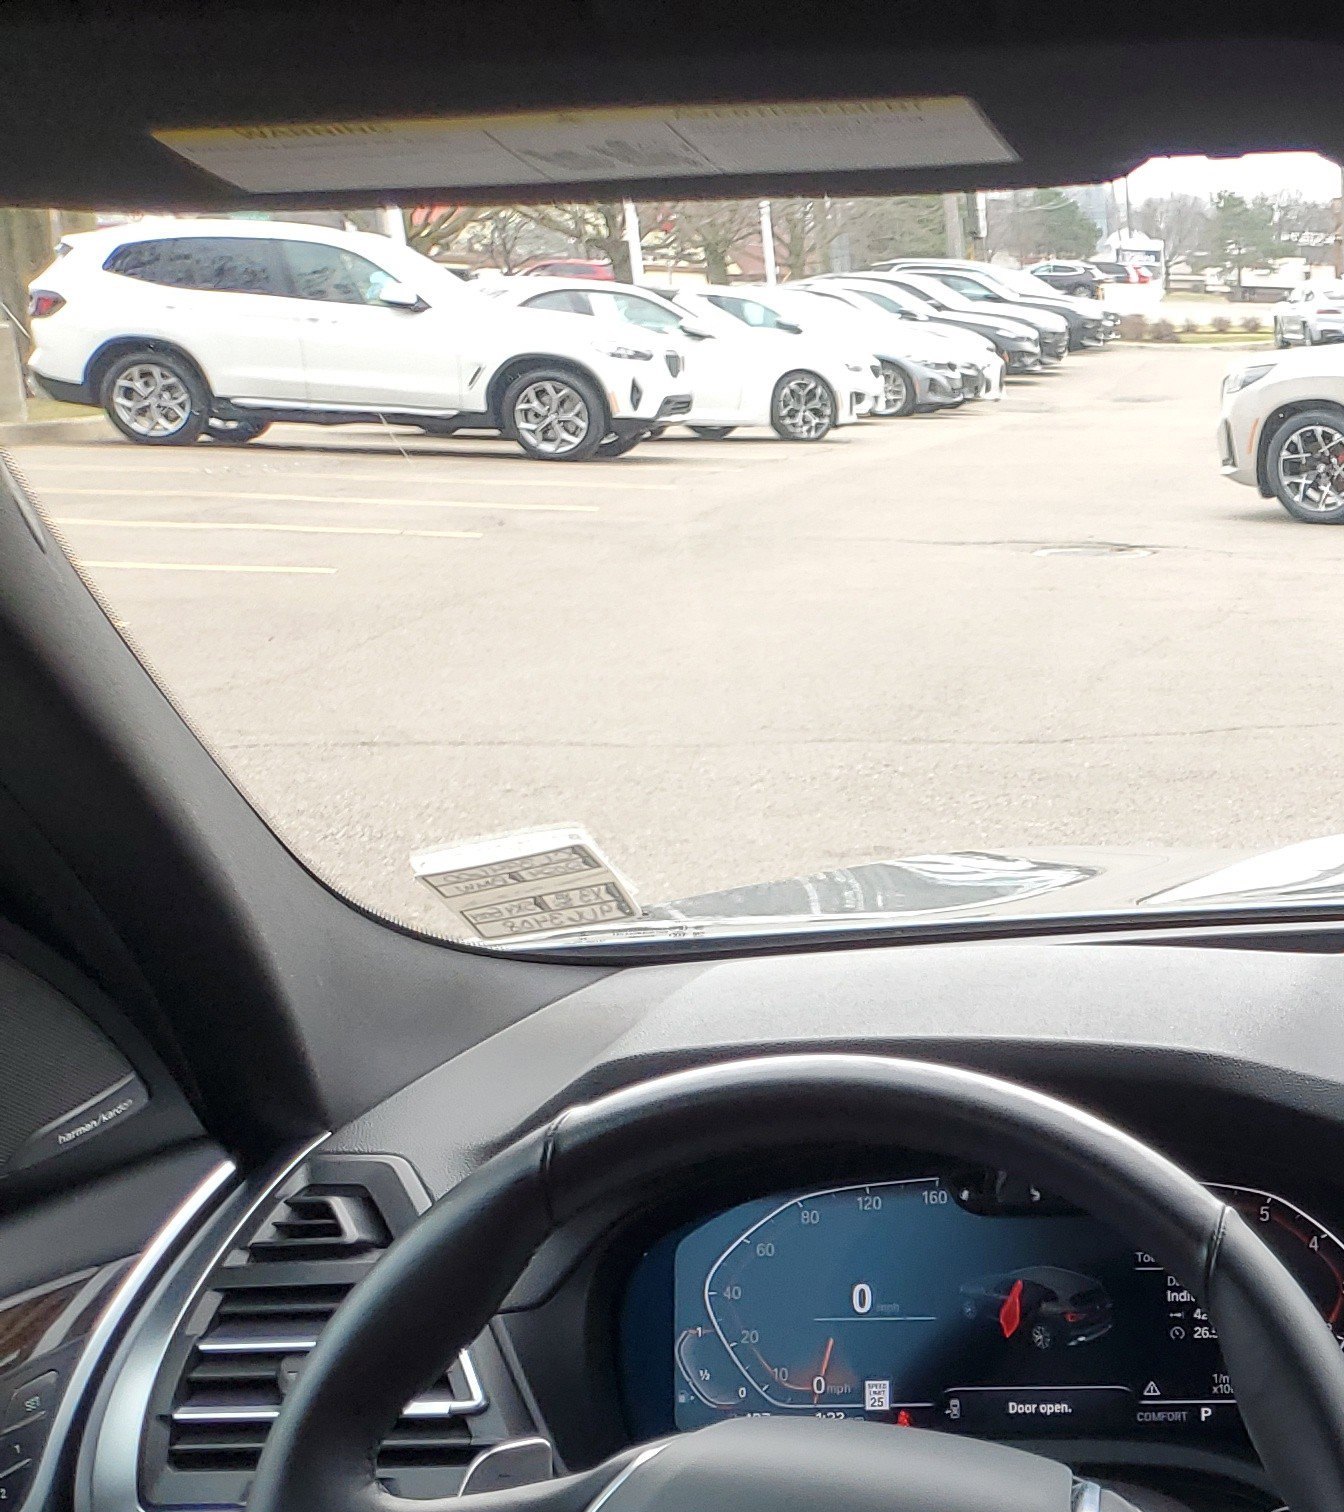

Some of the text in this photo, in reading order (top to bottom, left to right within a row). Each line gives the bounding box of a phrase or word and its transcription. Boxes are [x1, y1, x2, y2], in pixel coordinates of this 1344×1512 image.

[856, 1196, 882, 1211] 120
[922, 1190, 948, 1205] 160
[800, 1211, 820, 1225] 80
[1259, 1206, 1270, 1222] 5
[756, 1243, 775, 1257] 60
[1308, 1235, 1319, 1251] 4
[722, 1286, 742, 1300] 40
[852, 1283, 873, 1314] 0
[741, 1330, 759, 1344] 20
[772, 1367, 789, 1382] 10
[812, 1376, 826, 1395] 0
[738, 1387, 747, 1399] 0
[870, 1396, 884, 1408] 25
[1008, 1402, 1073, 1416] Door open.
[1136, 1411, 1188, 1422] COMFORT
[1200, 1408, 1213, 1422] P
